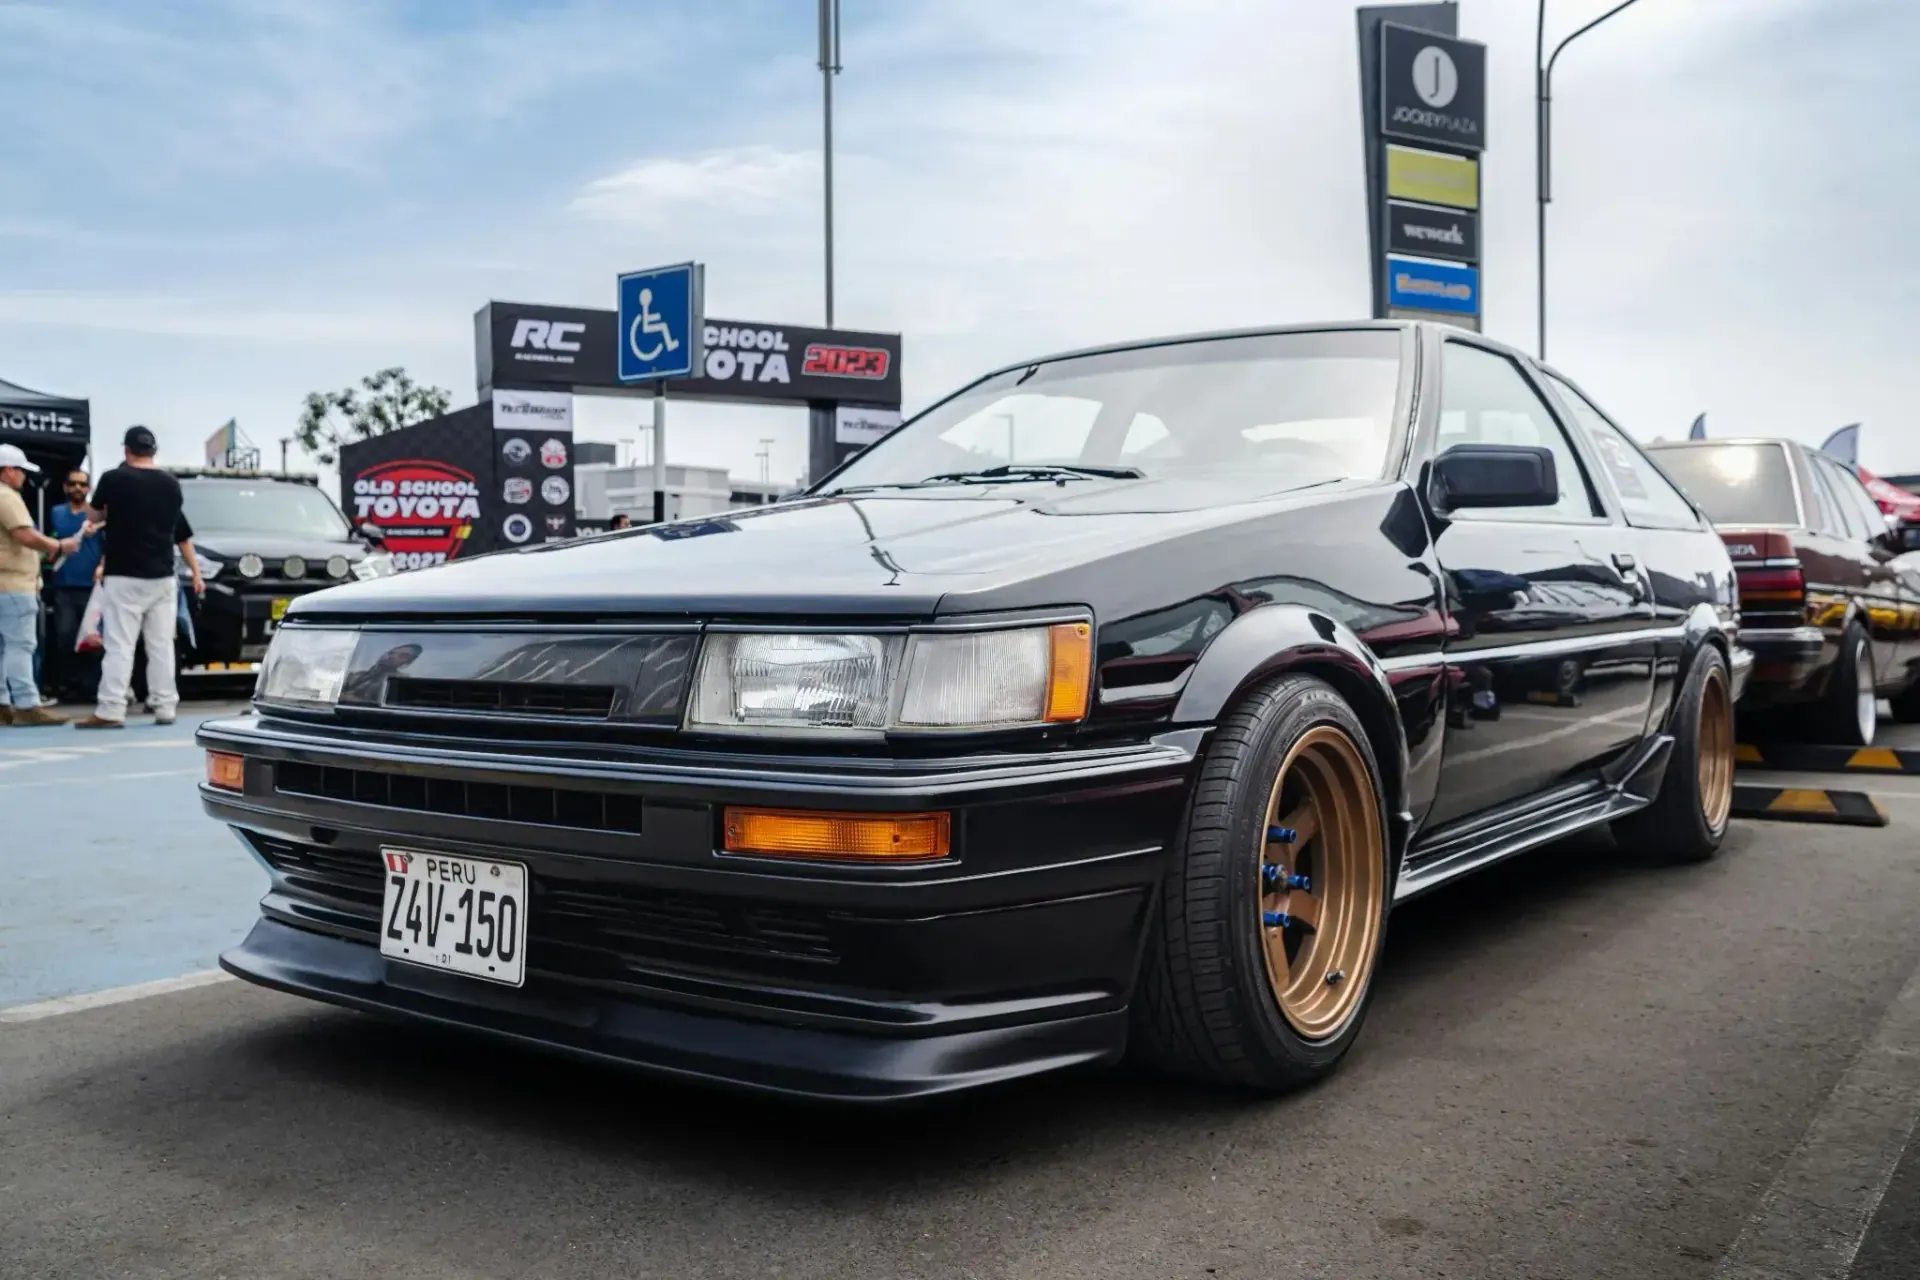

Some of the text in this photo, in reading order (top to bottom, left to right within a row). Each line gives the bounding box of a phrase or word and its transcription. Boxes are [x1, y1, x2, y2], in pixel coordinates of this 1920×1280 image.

[510, 319, 586, 352] RC
[703, 325, 789, 351] CHOOL
[704, 350, 790, 383] OTA
[803, 344, 888, 379] 2023
[353, 479, 480, 497] OLD SCHOOL
[353, 495, 481, 519] TOYOTA
[426, 858, 477, 886] PERU
[386, 875, 517, 963] Z4V-150
